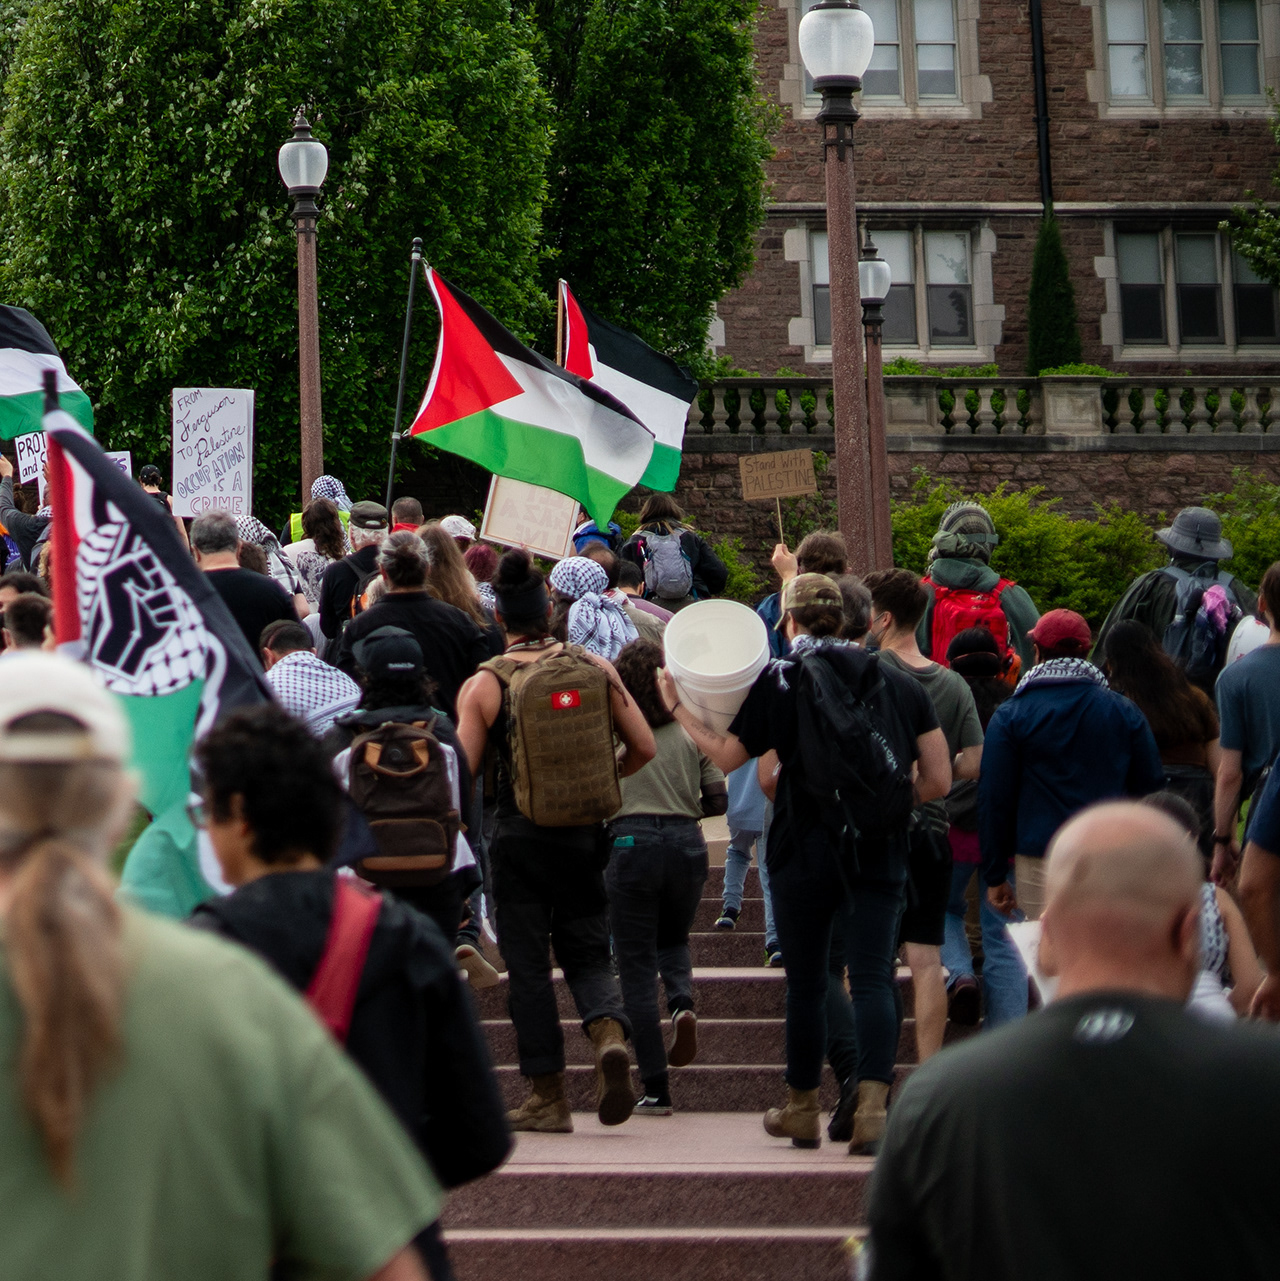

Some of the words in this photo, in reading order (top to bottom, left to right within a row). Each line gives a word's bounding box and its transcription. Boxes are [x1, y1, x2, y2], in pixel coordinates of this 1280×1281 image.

[176, 389, 203, 412] FROM
[175, 395, 236, 443] Ferguson
[176, 445, 194, 460] TO
[193, 424, 246, 467] Palestine
[22, 457, 38, 478] and
[176, 441, 246, 499] OCCUPATION
[744, 453, 776, 474] Stand
[232, 470, 243, 492] A
[744, 467, 815, 493] PALESTINE
[190, 495, 243, 515] CRIME
